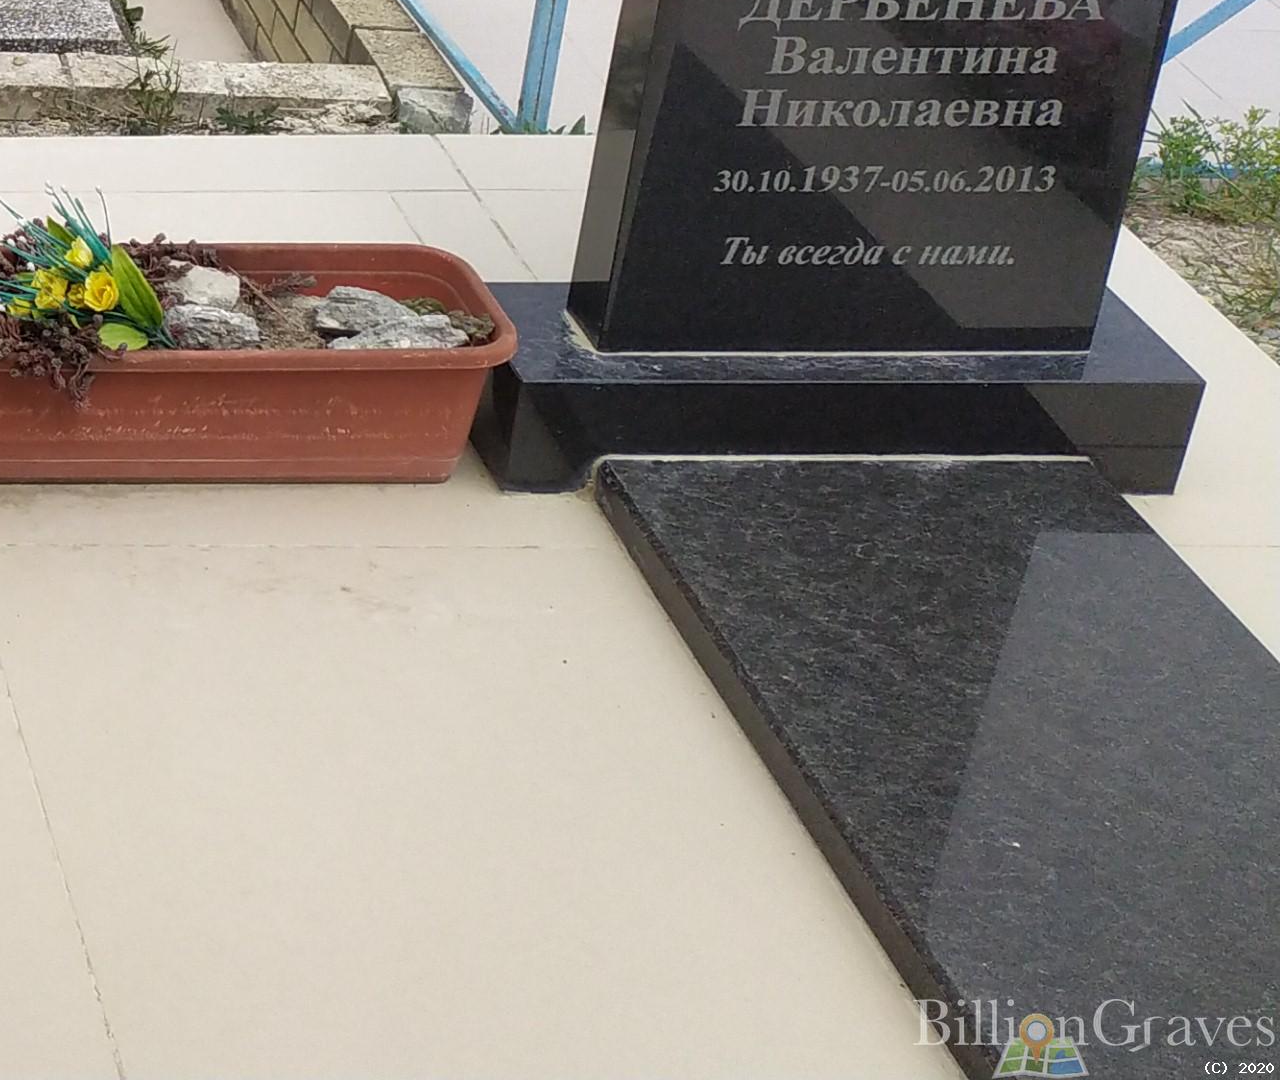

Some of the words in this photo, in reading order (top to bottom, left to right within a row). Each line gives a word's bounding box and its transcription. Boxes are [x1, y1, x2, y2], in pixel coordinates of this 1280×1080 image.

[765, 35, 1059, 76] Валентина
[736, 88, 1065, 128] Николаевна
[712, 165, 1057, 194] 30.10.1937-05.06.2013
[719, 235, 767, 266] Ты
[777, 236, 884, 266] всегда
[891, 244, 913, 266] с
[917, 244, 1016, 266] нами.
